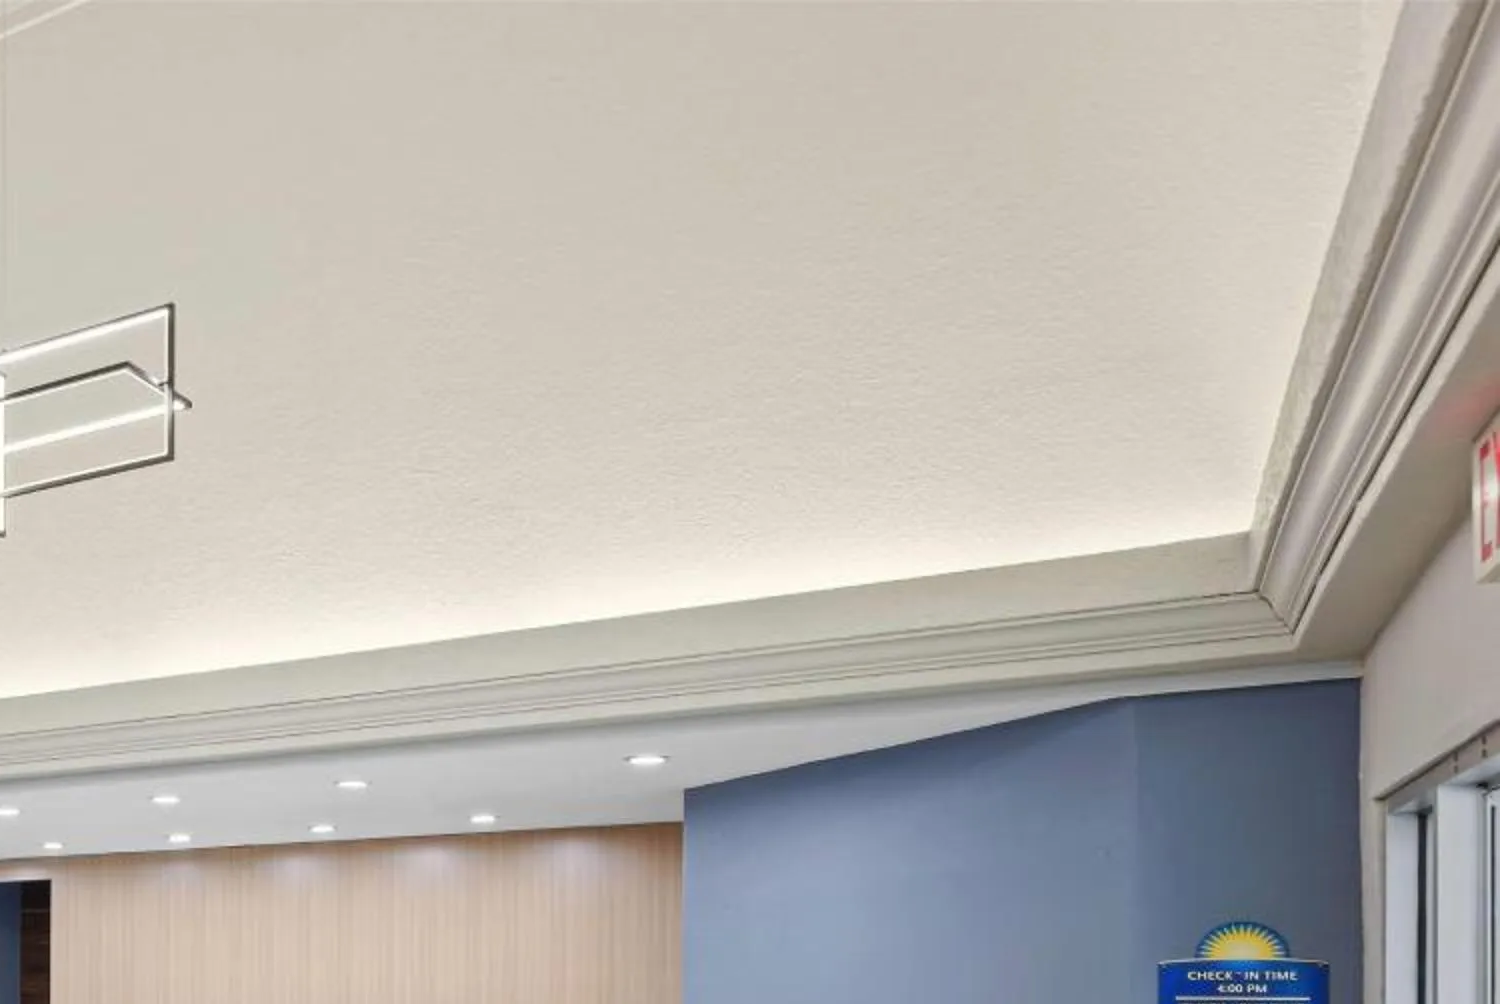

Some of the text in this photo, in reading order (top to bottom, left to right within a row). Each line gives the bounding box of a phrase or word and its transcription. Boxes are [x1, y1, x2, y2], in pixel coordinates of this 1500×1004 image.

[1187, 971, 1233, 981] CHECK
[1243, 971, 1260, 981] IN
[1264, 971, 1299, 981] TIME
[1247, 983, 1268, 993] PM
